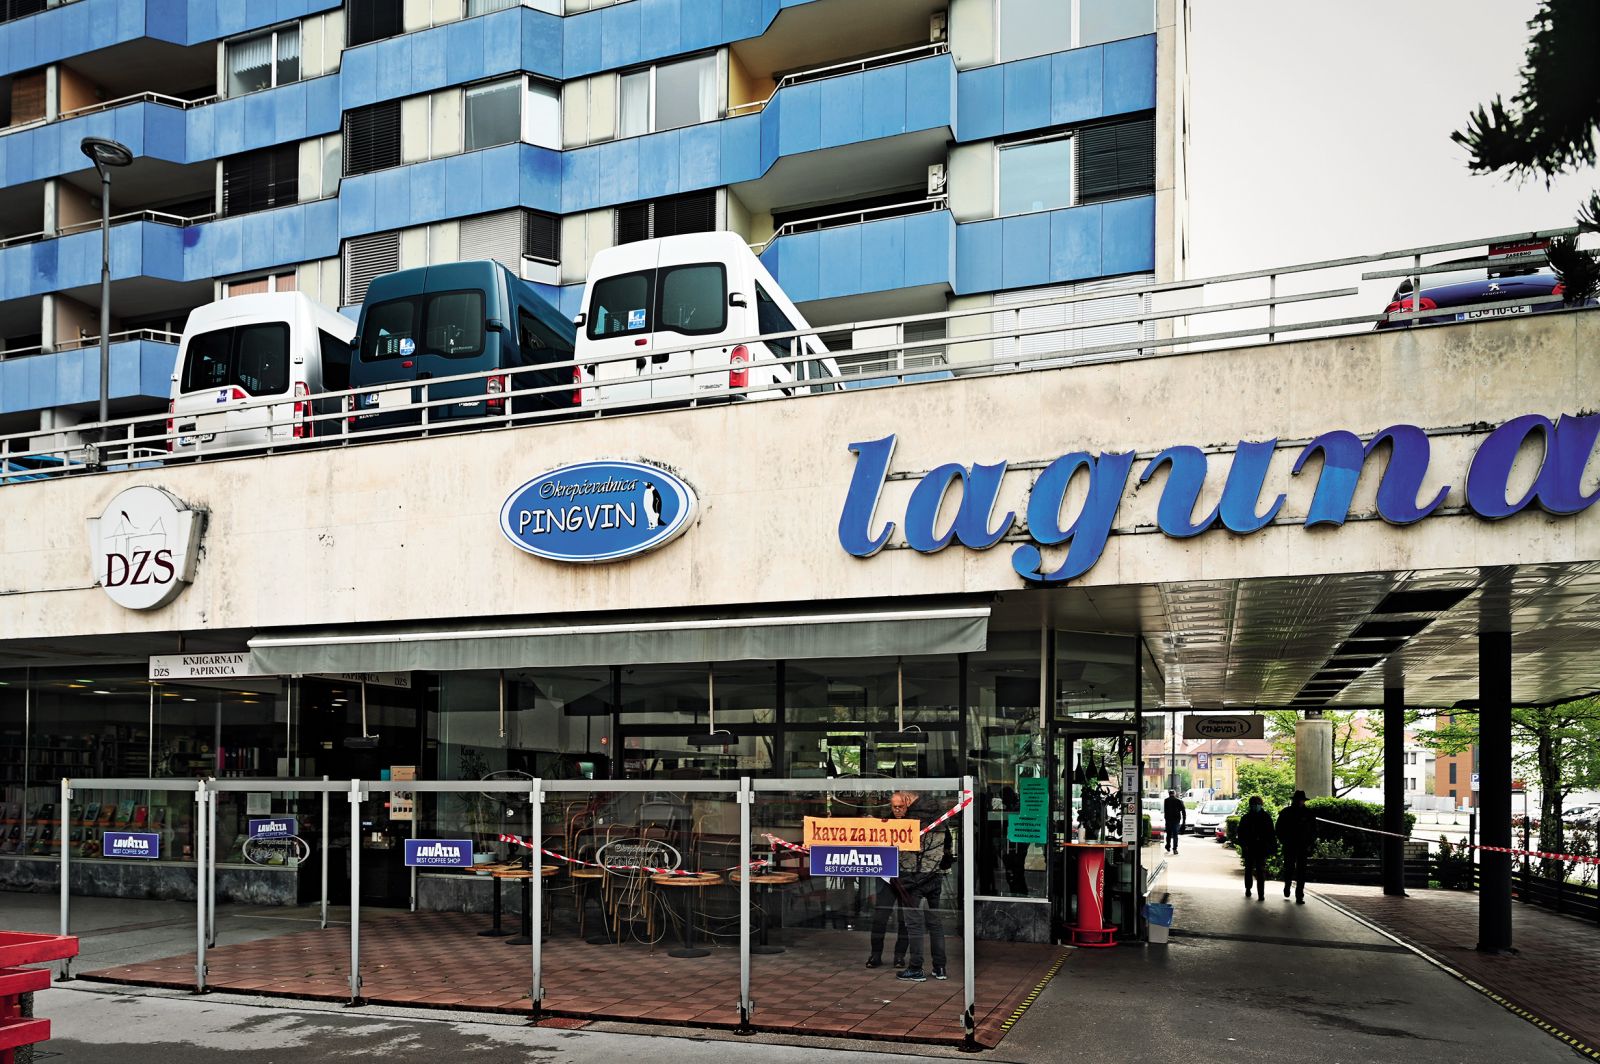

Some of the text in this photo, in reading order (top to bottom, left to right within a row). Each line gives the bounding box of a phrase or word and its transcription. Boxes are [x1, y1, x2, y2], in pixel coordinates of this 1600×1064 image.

[838, 411, 1600, 582] laguna
[519, 501, 637, 535] PINGVIN
[105, 549, 175, 587] DZS
[182, 655, 244, 666] KNJIGARNA IN
[153, 668, 170, 677] DZS
[190, 666, 236, 676] PAPIRNICA
[257, 821, 287, 832] LAVAZZA
[812, 821, 913, 846] kava za na pot
[113, 836, 149, 849] LAVAZZA
[417, 843, 460, 857] LAVAZZA
[825, 850, 882, 865] LAVAZZA
